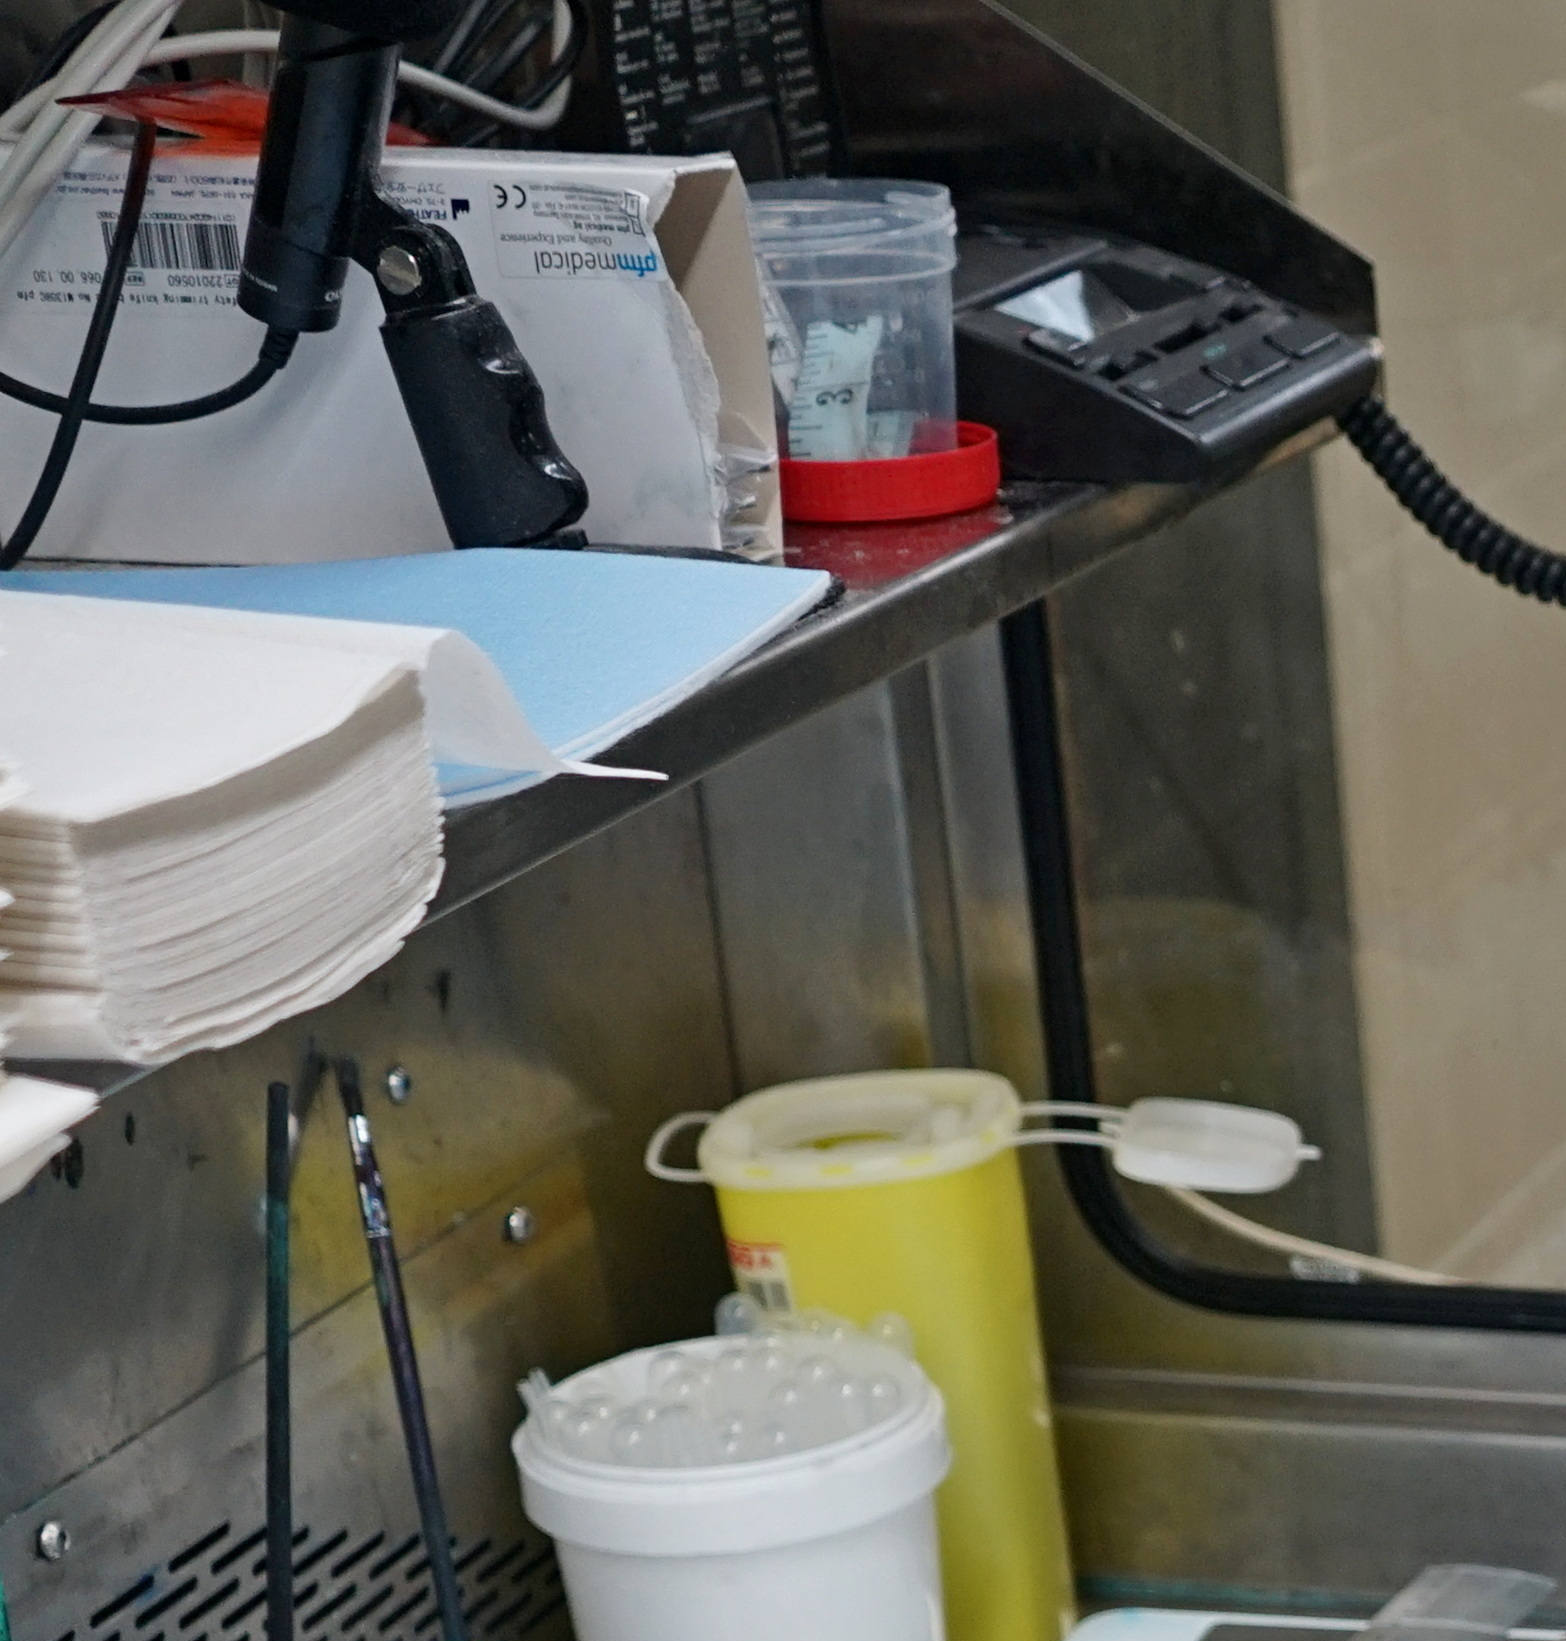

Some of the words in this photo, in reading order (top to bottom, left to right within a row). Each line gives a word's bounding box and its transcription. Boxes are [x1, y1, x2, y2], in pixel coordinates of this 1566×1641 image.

[500, 233, 555, 246] Experience
[557, 234, 577, 246] and
[578, 234, 613, 246] Quality
[167, 274, 222, 287] 22010560
[128, 293, 159, 306] knife
[162, 292, 209, 306] trimming
[815, 388, 854, 407] 3
